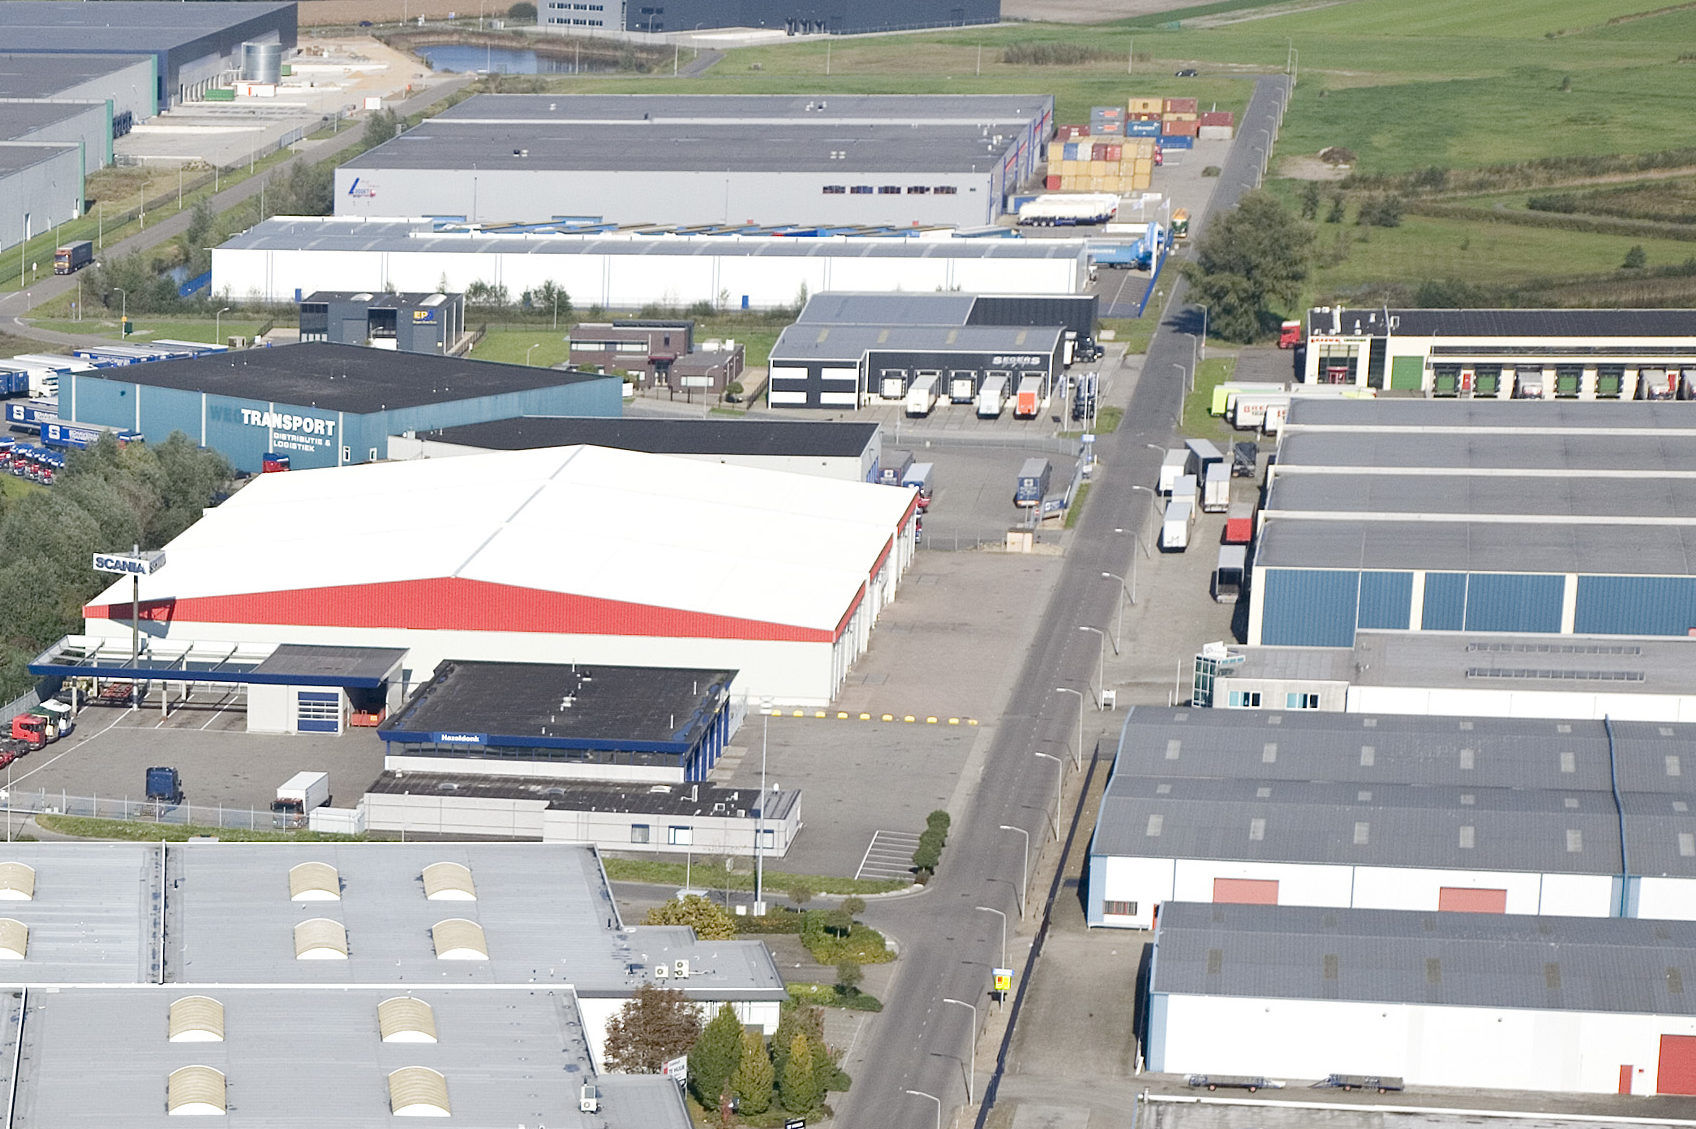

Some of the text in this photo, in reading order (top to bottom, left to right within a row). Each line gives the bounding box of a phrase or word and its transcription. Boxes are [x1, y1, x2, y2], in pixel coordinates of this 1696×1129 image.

[241, 408, 335, 436] TRANSPORT
[273, 432, 322, 445] DISTRIBUTIE
[273, 440, 315, 452] LOGISTIEK
[95, 556, 147, 575] SCANIA
